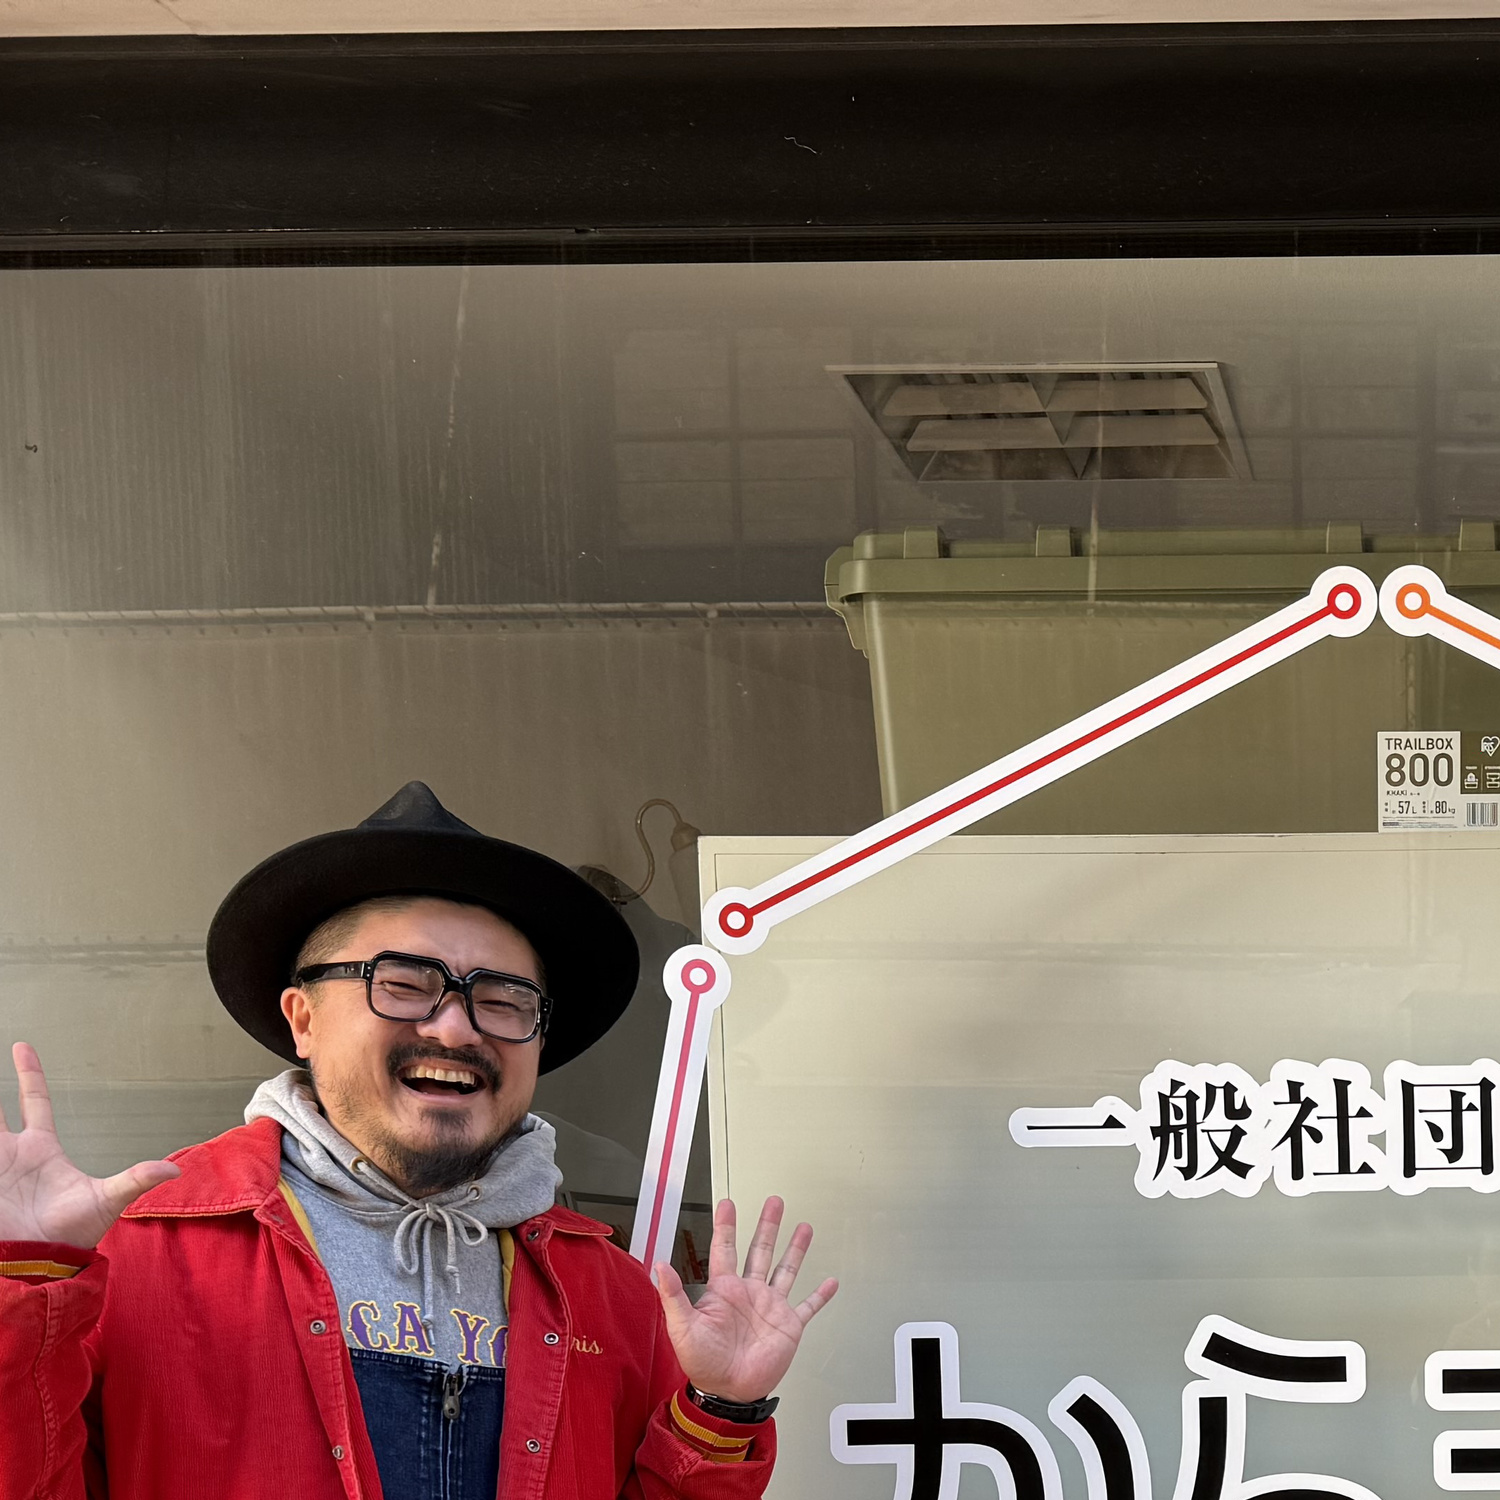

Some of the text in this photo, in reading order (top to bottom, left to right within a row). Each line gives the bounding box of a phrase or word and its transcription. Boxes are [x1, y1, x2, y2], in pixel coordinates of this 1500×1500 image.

[1385, 737, 1454, 751] TRAILBOX
[1385, 752, 1454, 787] 800
[571, 1335, 604, 1355] ris
